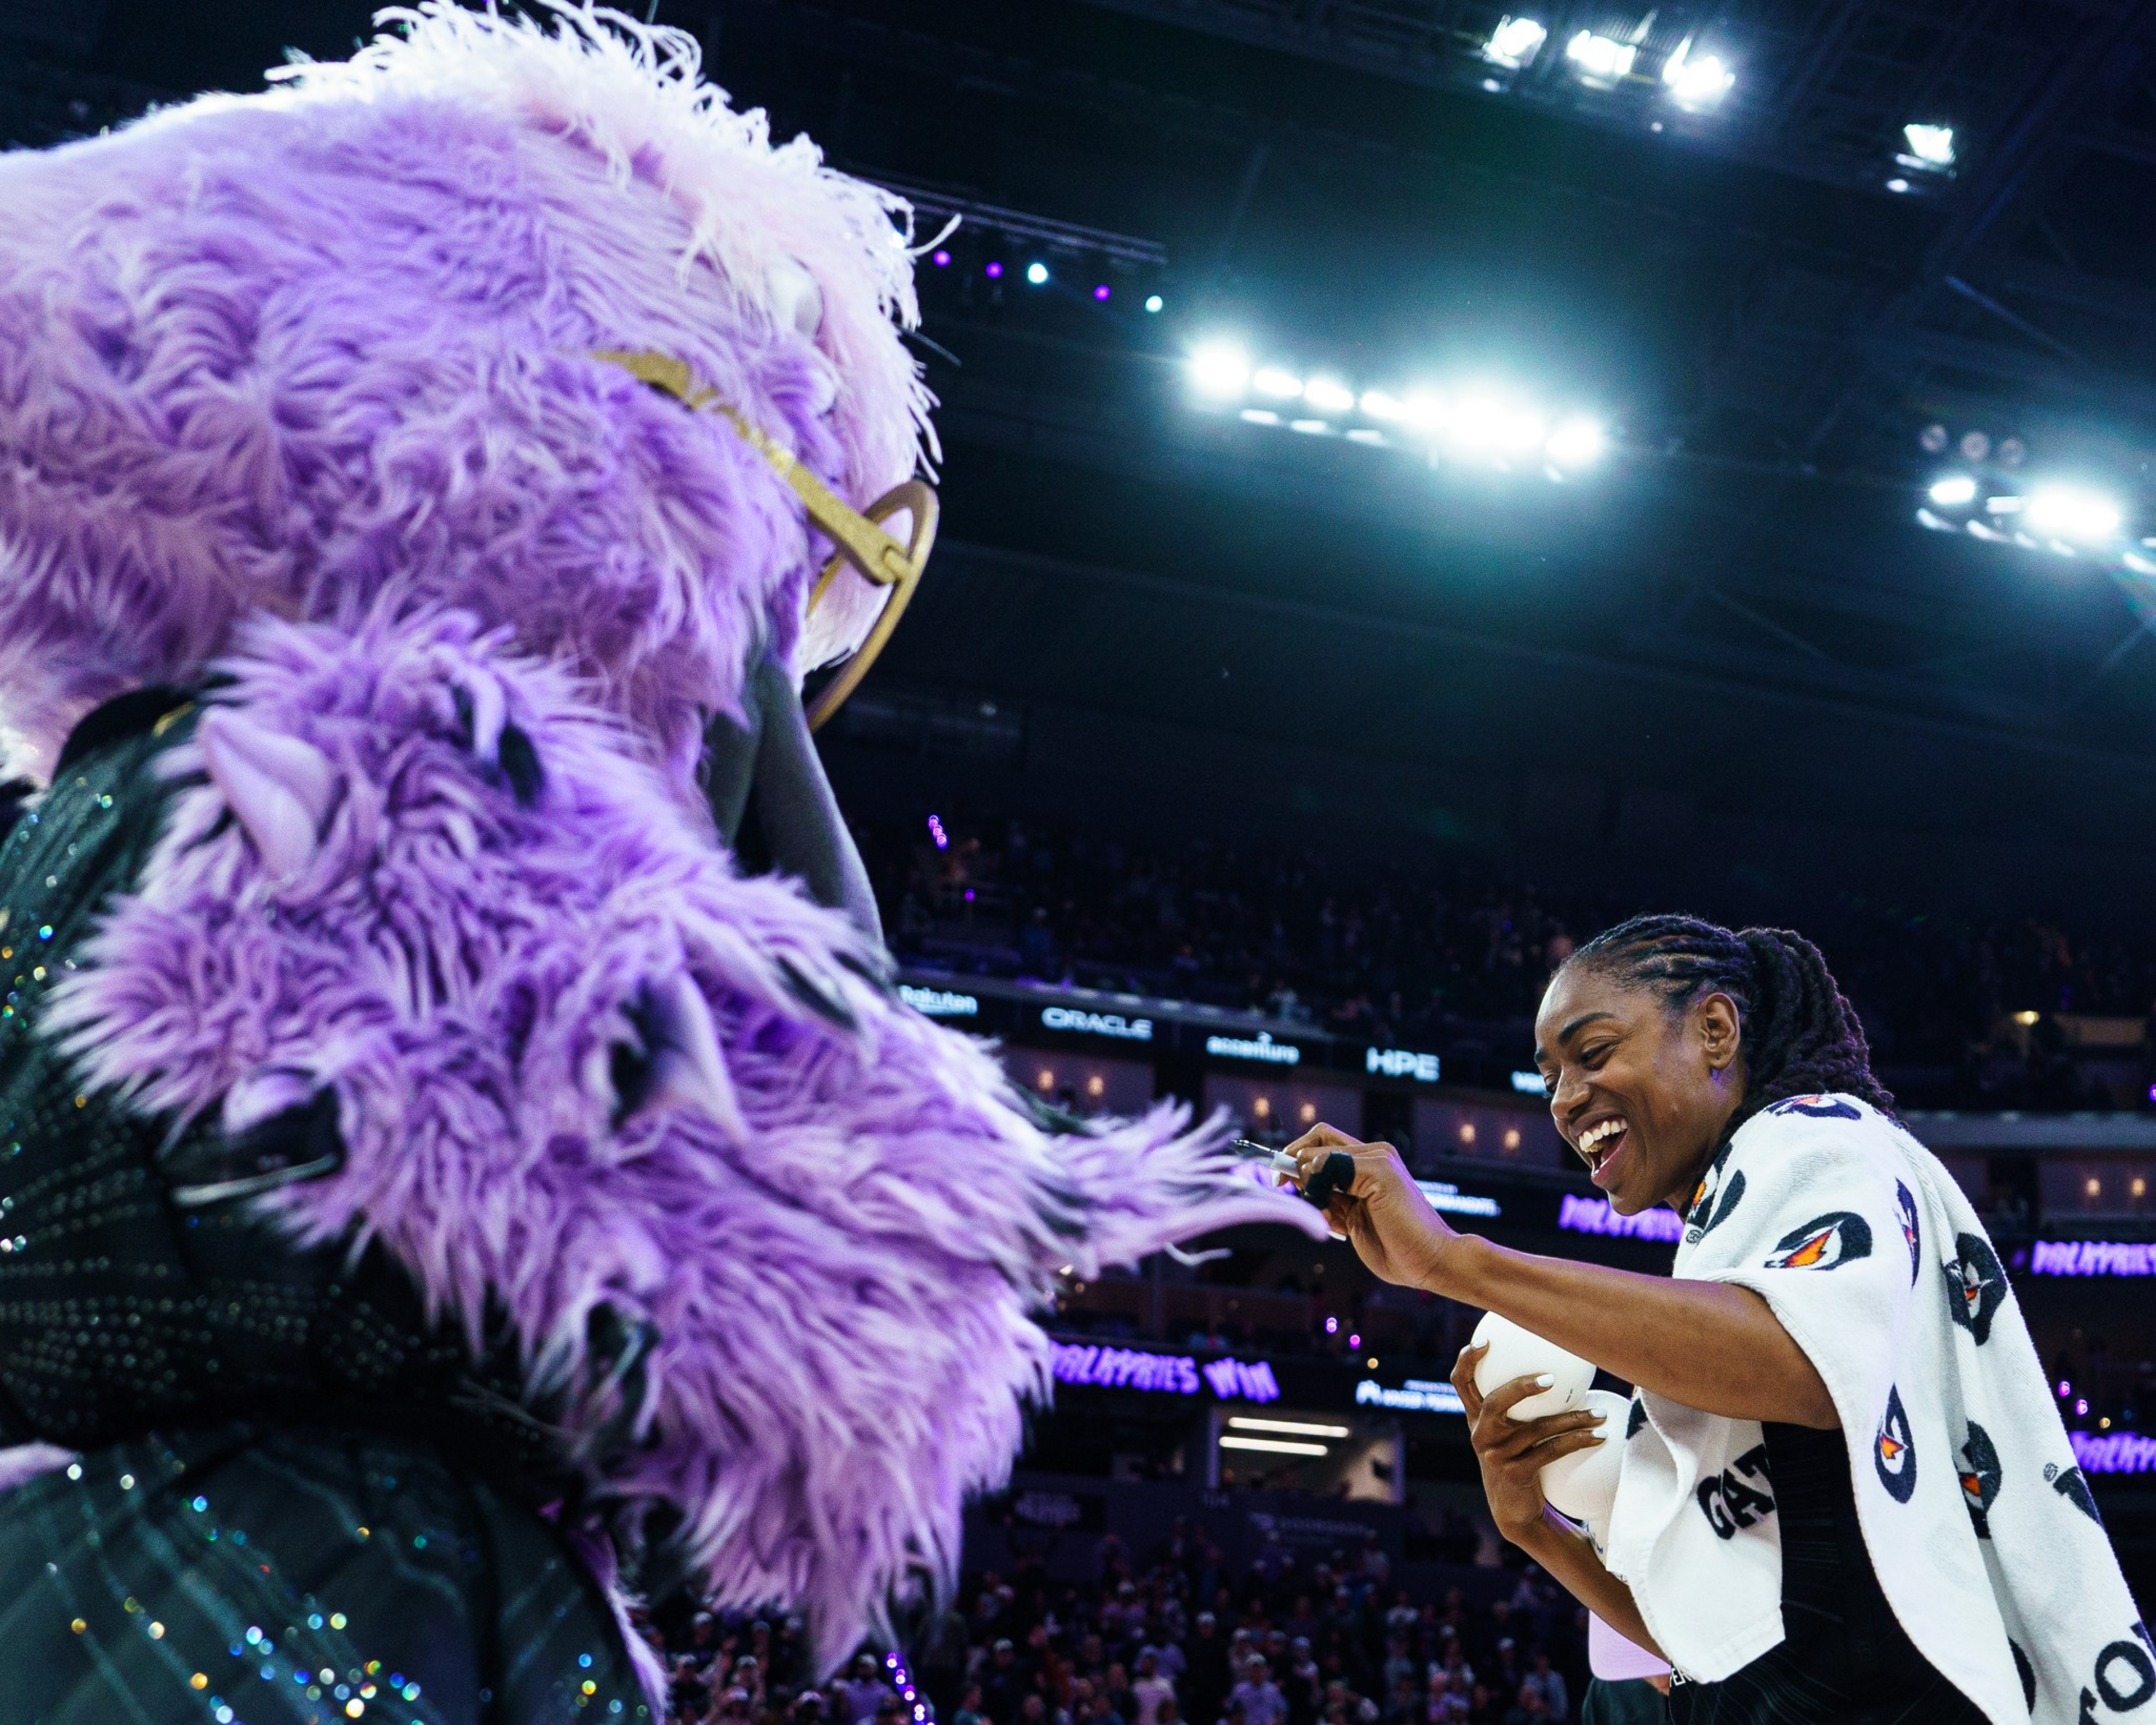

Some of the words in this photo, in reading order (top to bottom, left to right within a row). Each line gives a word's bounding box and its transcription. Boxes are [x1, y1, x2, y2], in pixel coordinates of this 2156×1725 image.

[1042, 1007, 1153, 1039] ORACLE
[1366, 1047, 1440, 1081] HPE
[1203, 1357, 1280, 1403] WIN
